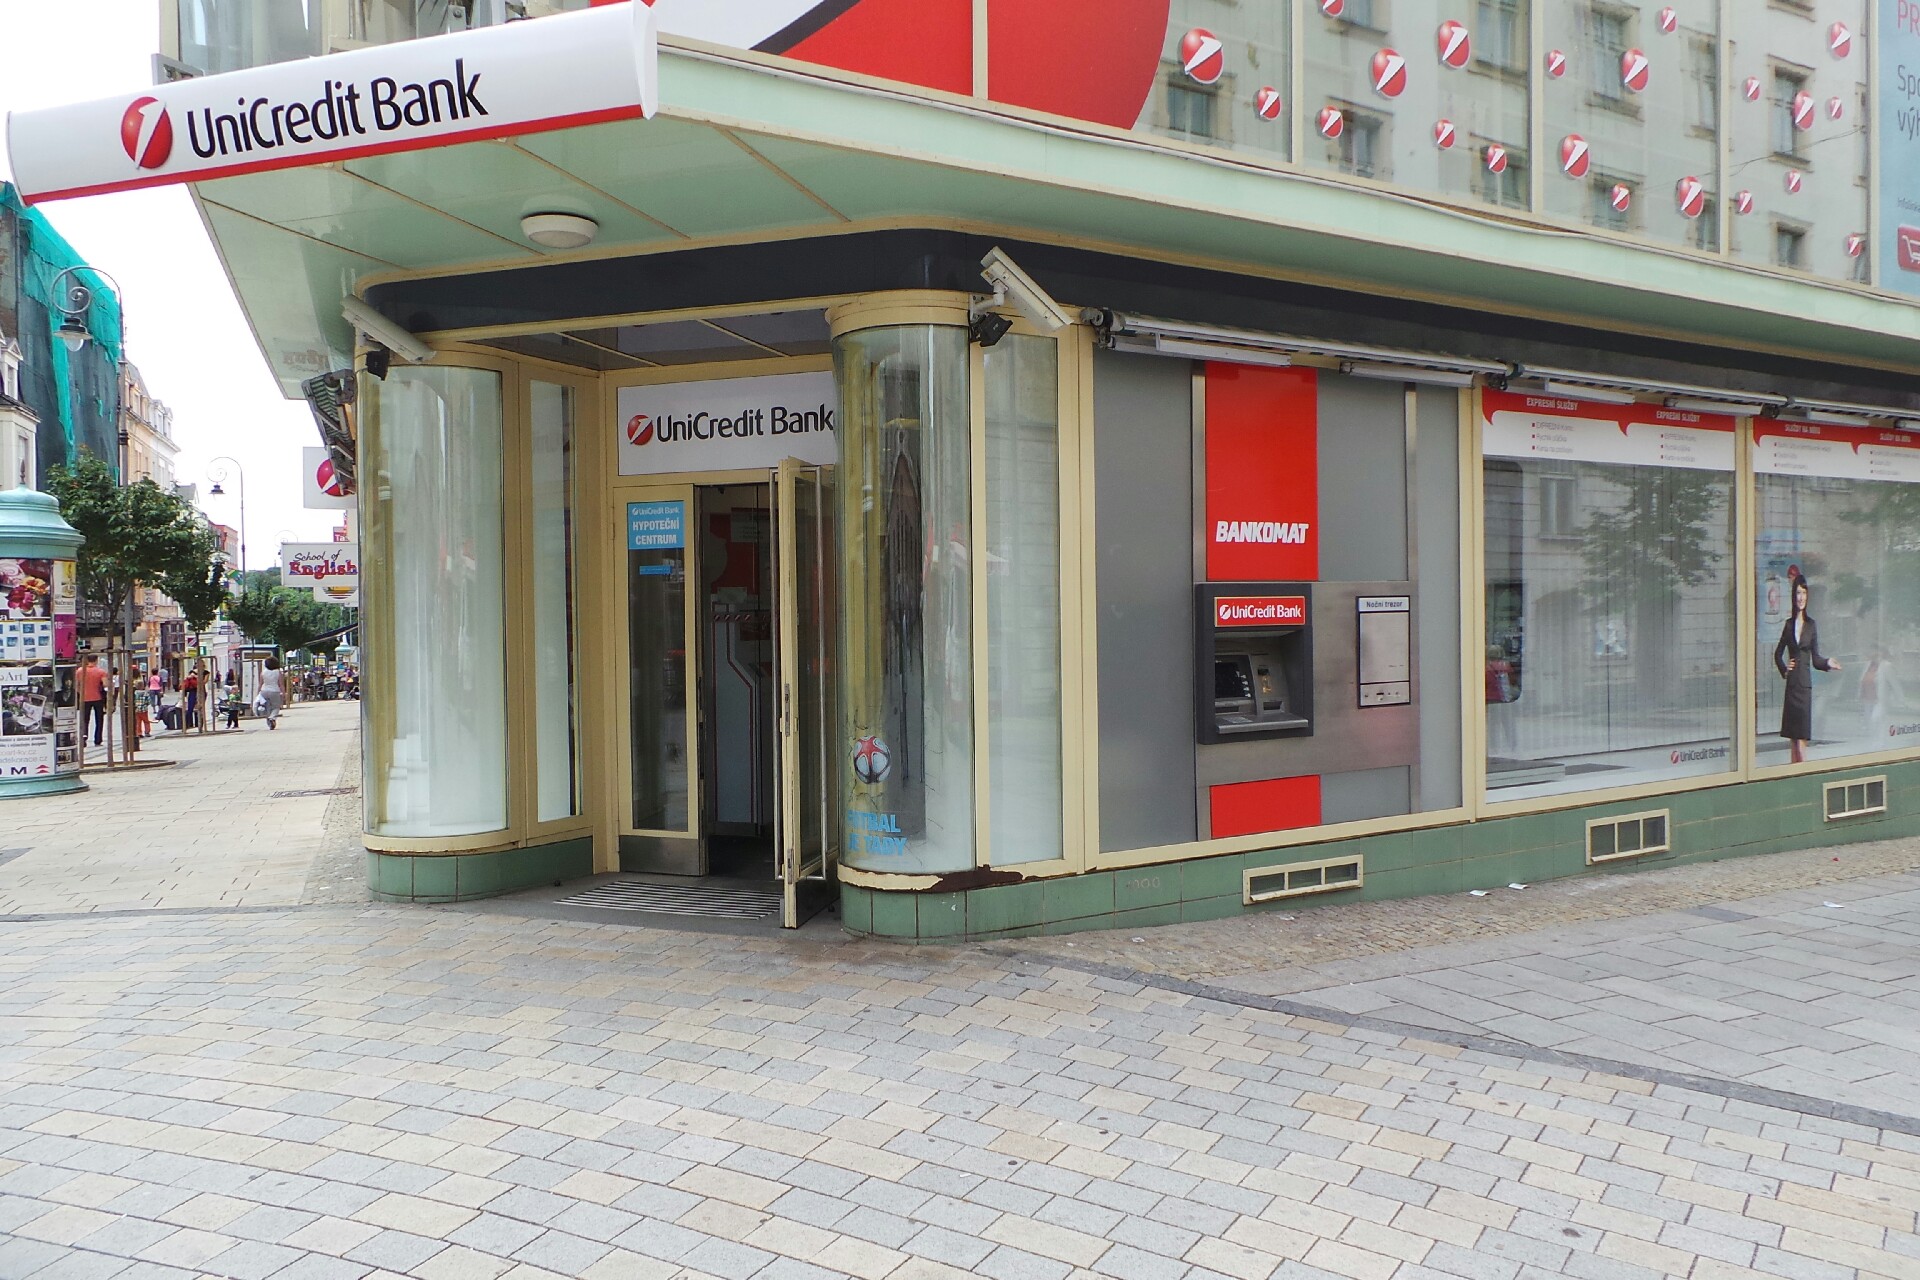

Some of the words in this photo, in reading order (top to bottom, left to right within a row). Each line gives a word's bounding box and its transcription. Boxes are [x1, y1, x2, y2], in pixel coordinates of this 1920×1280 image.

[187, 79, 366, 160] UniCredit
[371, 57, 489, 132] Bank
[656, 408, 764, 443] UniCredit
[770, 403, 834, 436] Bank
[639, 507, 664, 515] UniCredit
[632, 517, 680, 531] HYPOTEČNÍ
[635, 534, 677, 545] CENTRUM
[1215, 521, 1309, 544] BANKOMAT
[294, 551, 327, 561] School
[331, 549, 343, 561] of
[288, 560, 358, 580] English
[1232, 605, 1276, 619] UniCredit
[1276, 605, 1302, 618] Bank
[1680, 748, 1708, 762] UniCredit
[864, 835, 907, 857] TADY
